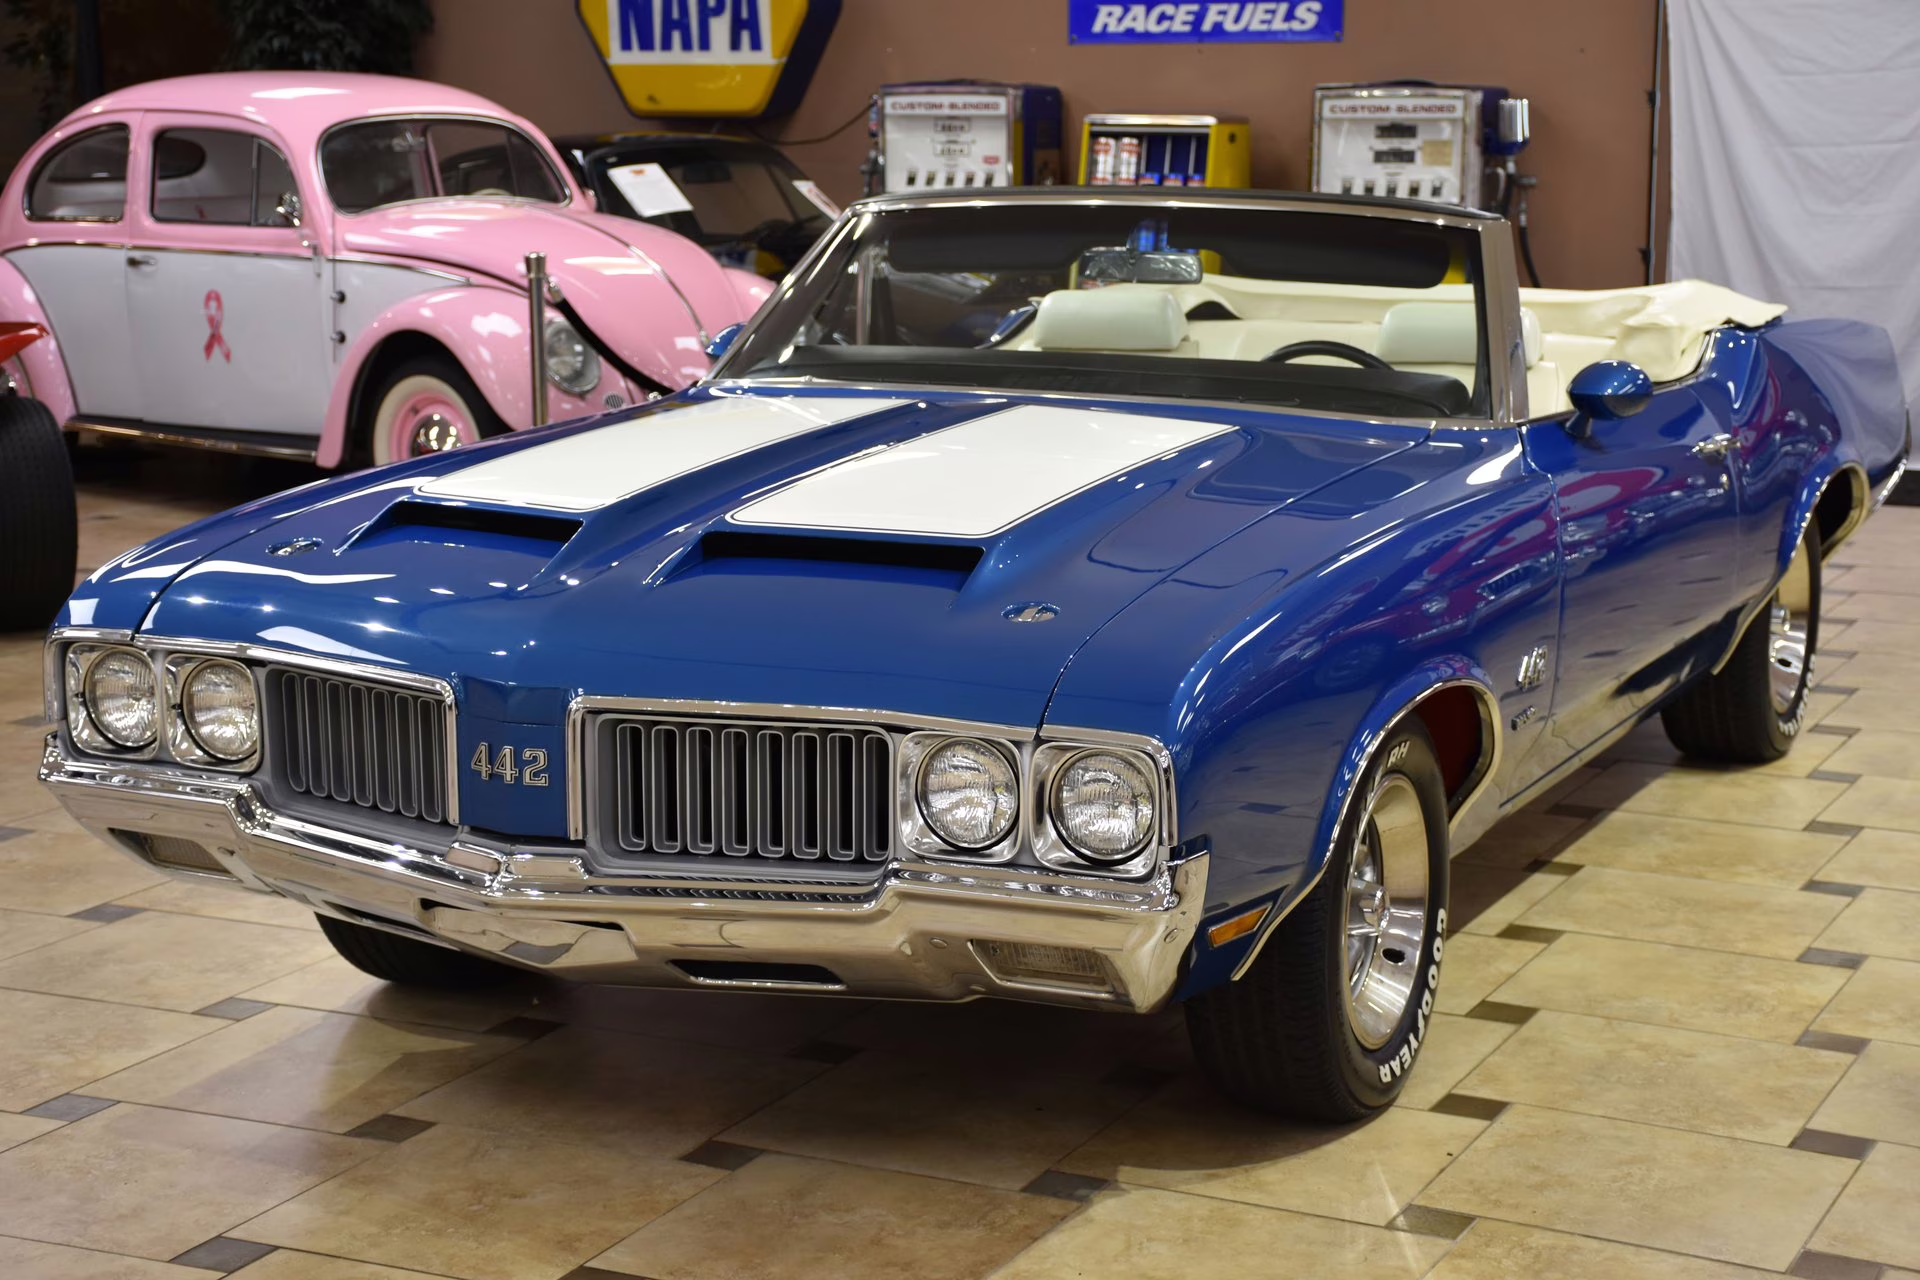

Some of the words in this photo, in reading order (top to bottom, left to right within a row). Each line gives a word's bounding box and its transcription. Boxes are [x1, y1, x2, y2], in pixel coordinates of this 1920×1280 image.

[619, 0, 762, 52] NAPA
[1091, 4, 1199, 34] RACE
[1200, 1, 1323, 33] FUELS
[471, 741, 549, 787] 442
[1379, 908, 1447, 1084] GOODYEAR
